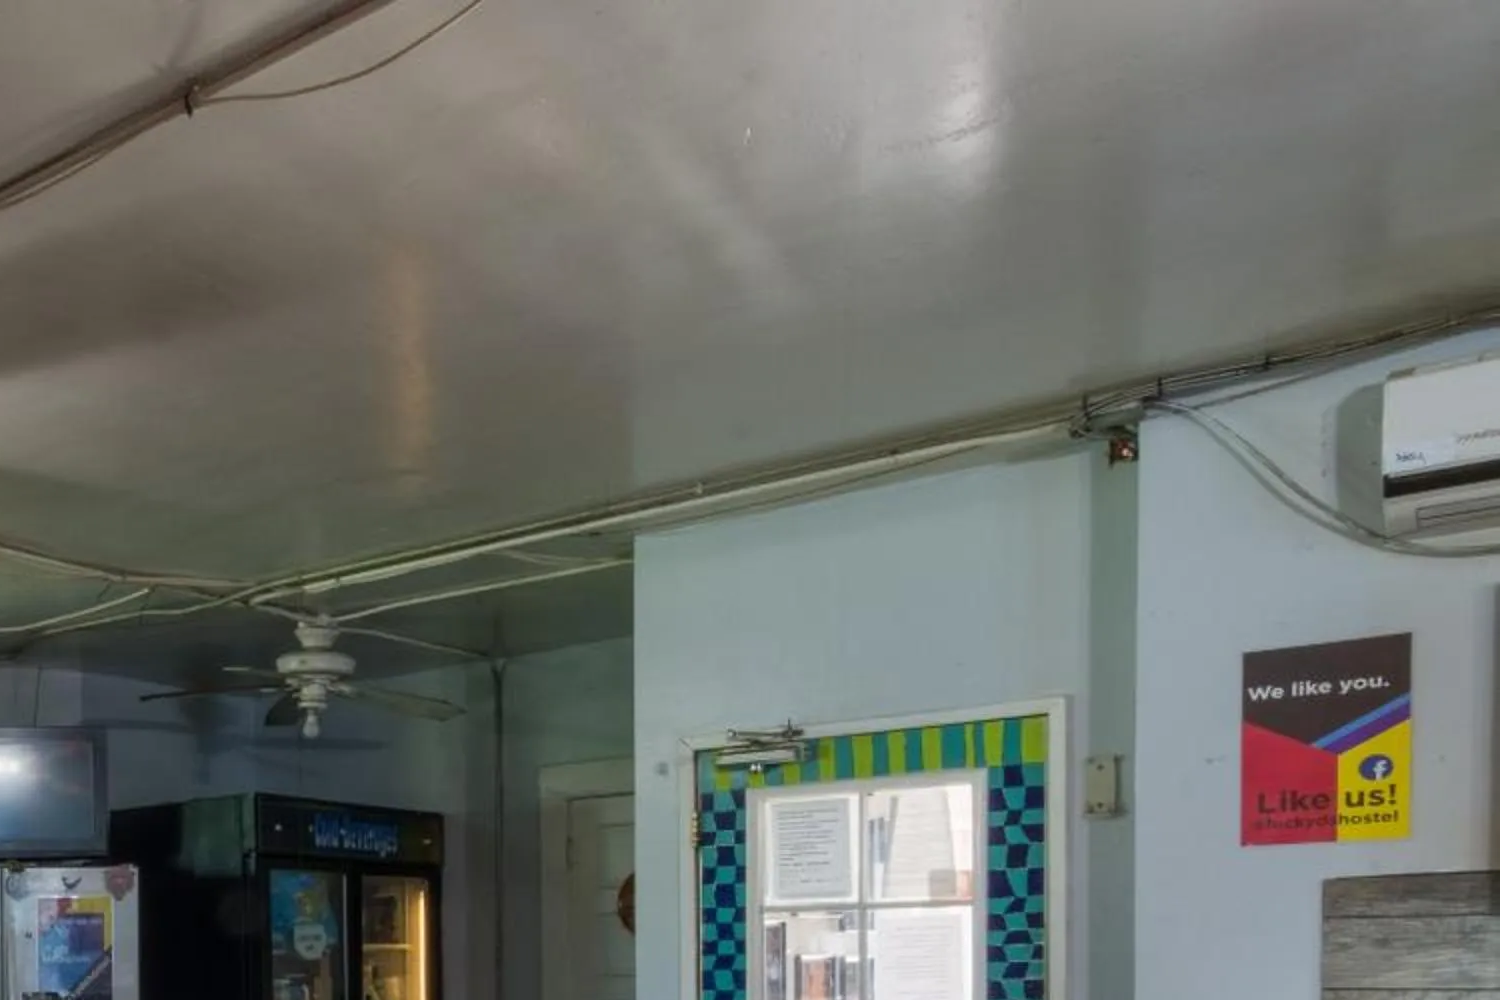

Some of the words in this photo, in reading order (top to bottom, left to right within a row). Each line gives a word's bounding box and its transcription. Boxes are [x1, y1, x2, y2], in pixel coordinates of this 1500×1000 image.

[1247, 686, 1284, 701] We
[1291, 680, 1332, 697] like
[1339, 676, 1390, 695] you.
[1257, 790, 1331, 814] Like
[1345, 784, 1397, 808] us!
